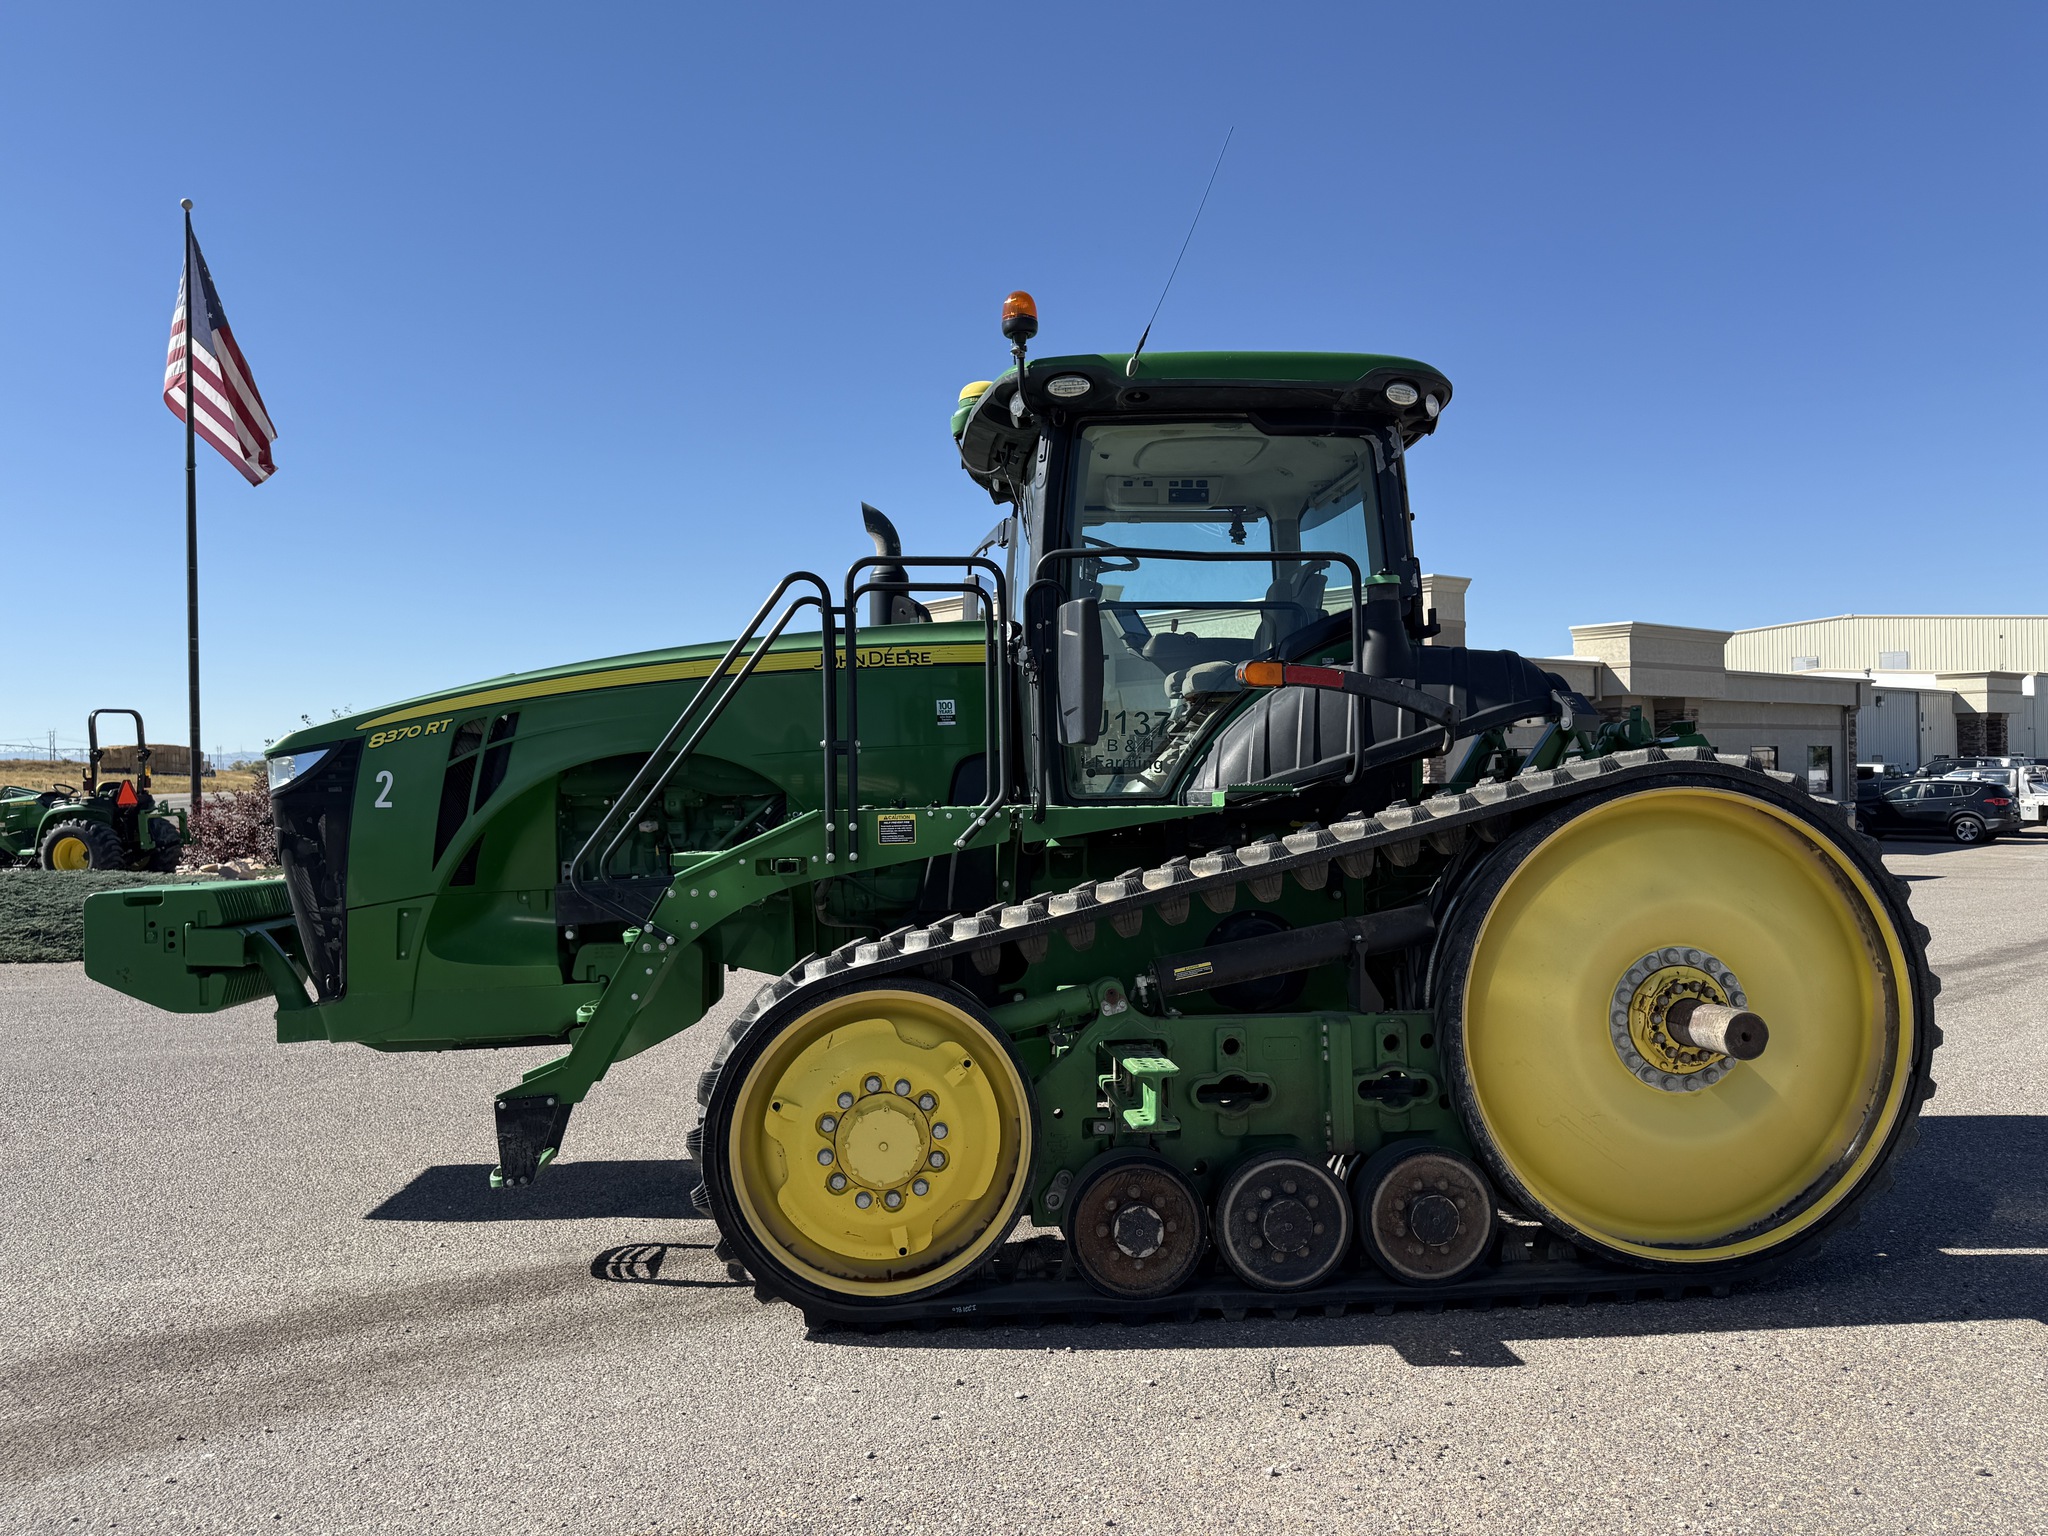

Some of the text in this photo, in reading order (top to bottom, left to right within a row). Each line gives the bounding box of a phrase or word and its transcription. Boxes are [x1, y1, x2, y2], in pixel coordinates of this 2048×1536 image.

[868, 651, 931, 665] DEERE
[938, 701, 952, 710] 100
[368, 718, 453, 748] 8370 RT
[1107, 739, 1153, 753] B & H
[1095, 755, 1163, 774] Farming
[374, 770, 394, 808] 2
